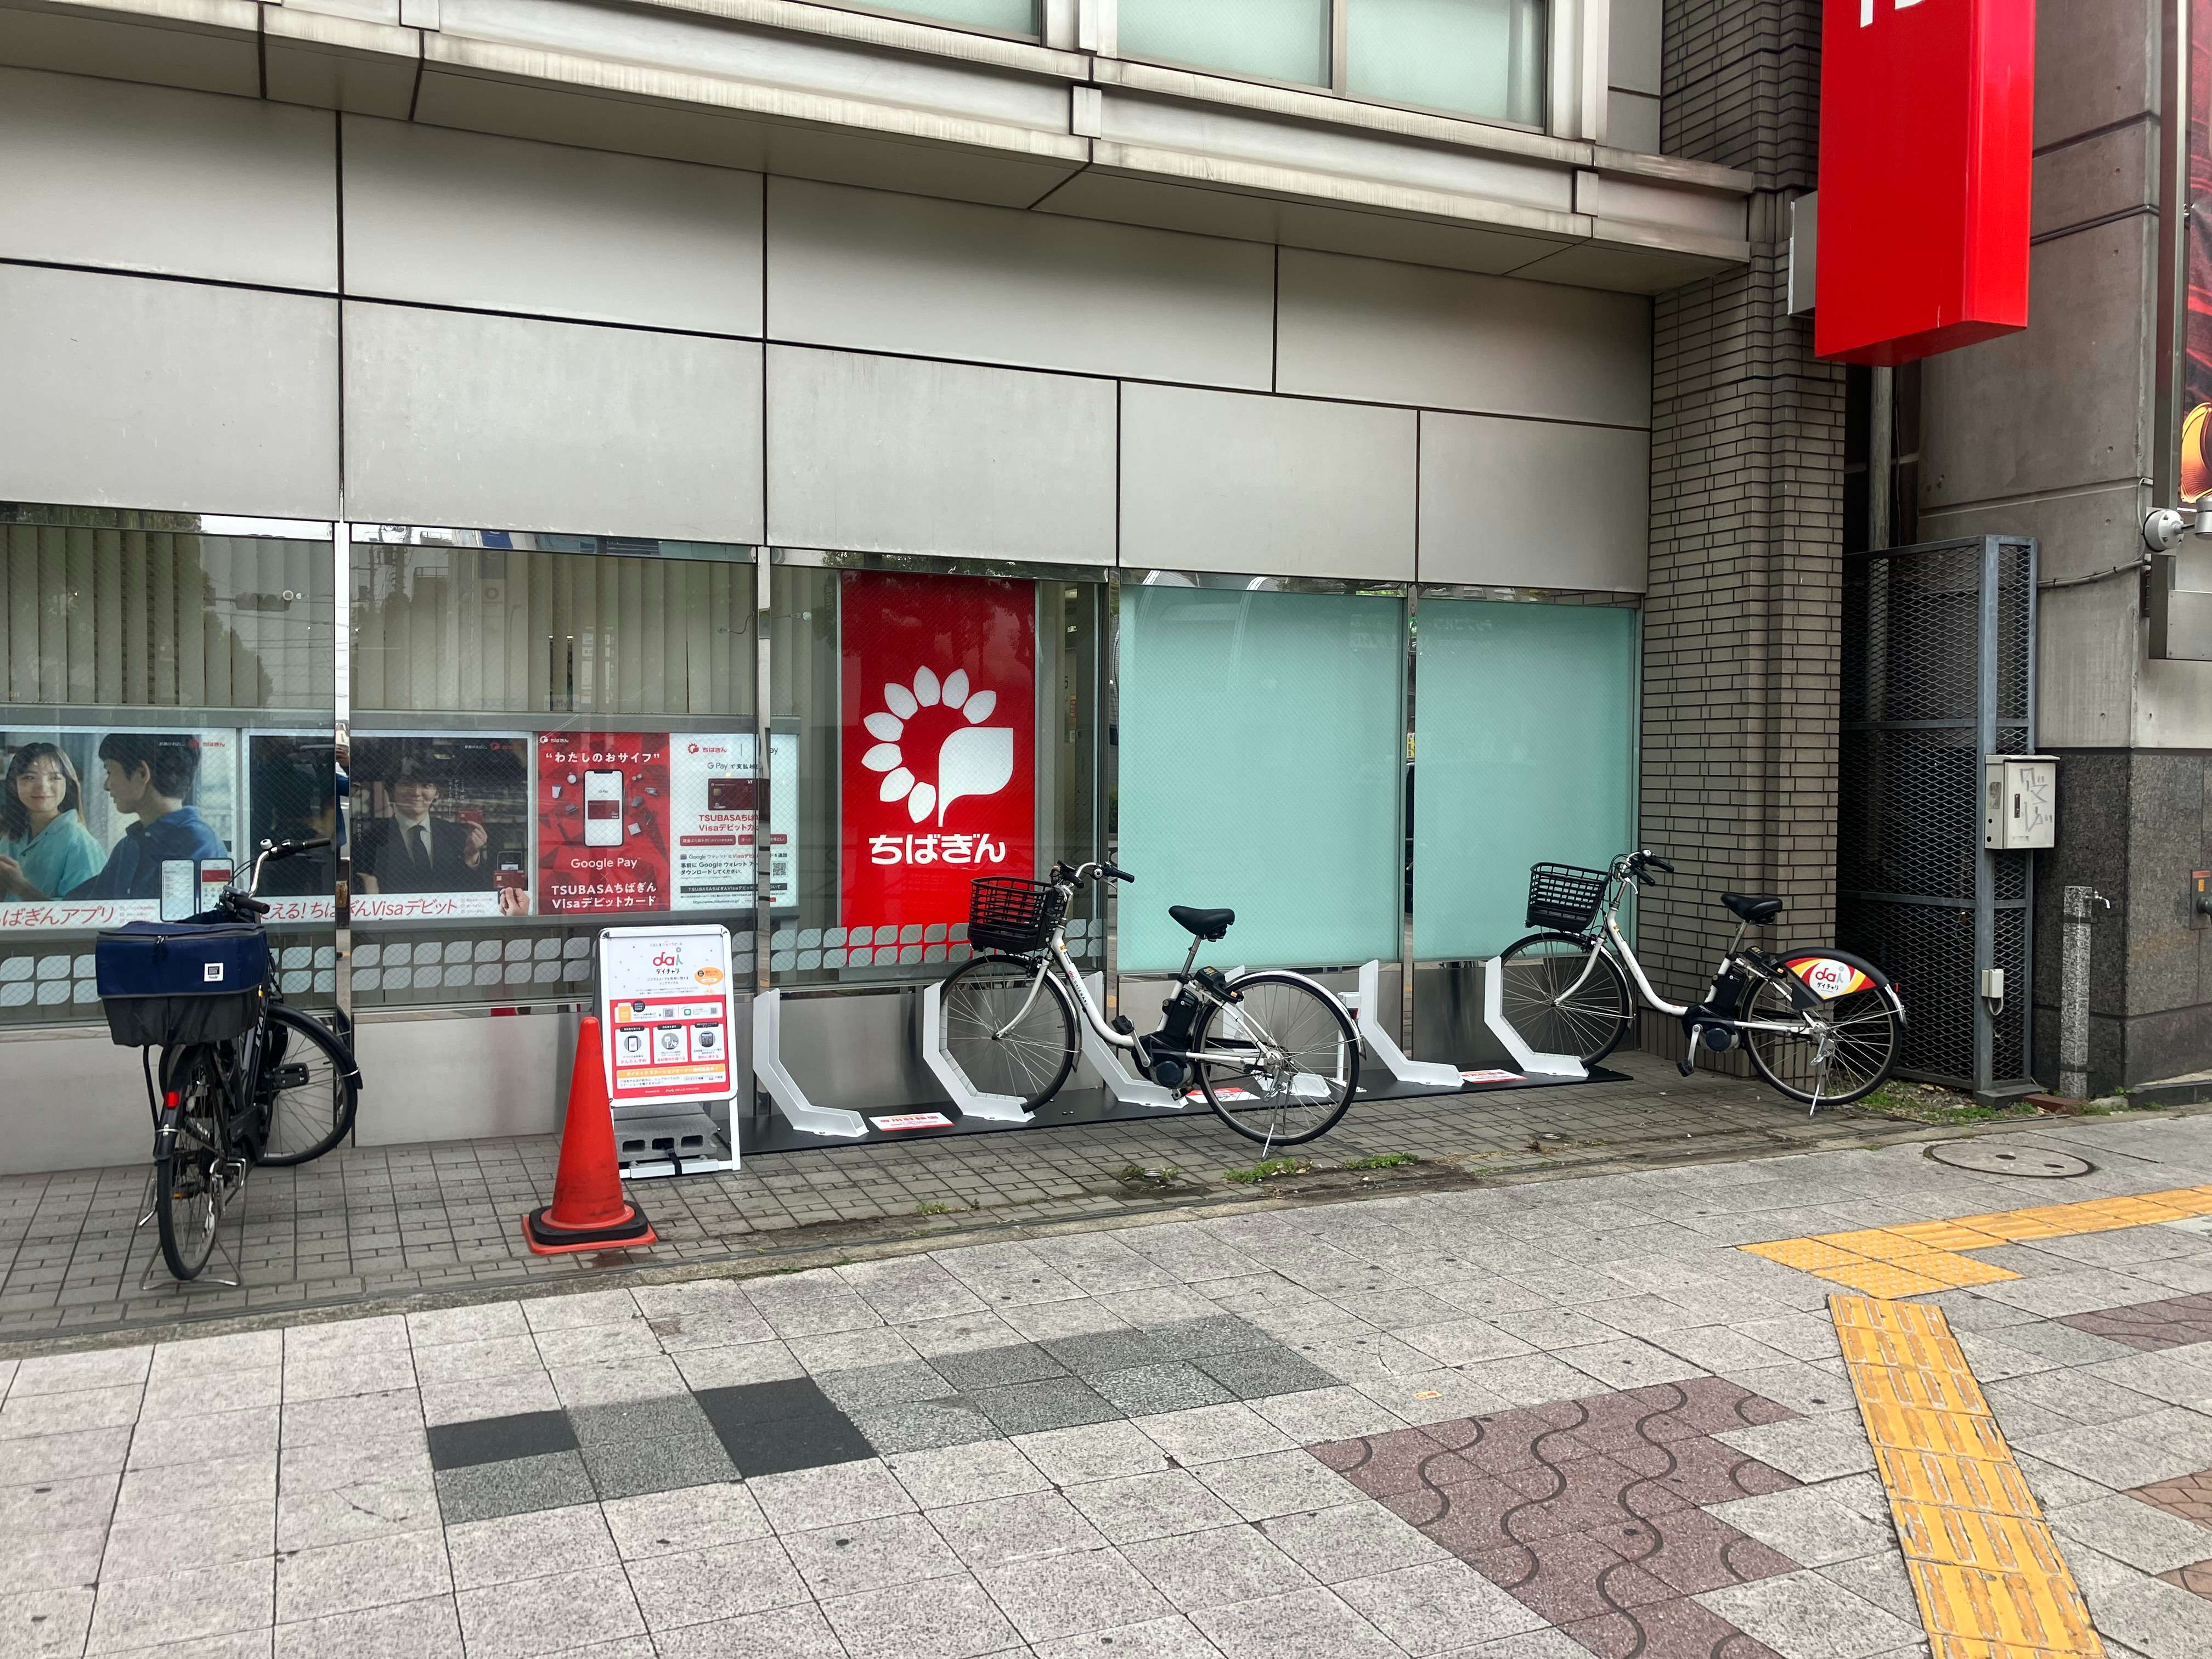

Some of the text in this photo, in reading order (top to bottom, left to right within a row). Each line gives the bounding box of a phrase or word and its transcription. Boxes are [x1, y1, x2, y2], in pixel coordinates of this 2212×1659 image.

[715, 763, 729, 771] Pay
[869, 833, 1006, 865] ちばぎん
[571, 857, 638, 870] Google Pay
[551, 882, 657, 895] TSUBASAちばぎん
[552, 895, 656, 909] Visaデビットカード
[0, 905, 114, 926] ばぎんアプリ
[1815, 966, 1844, 984] dai
[1817, 982, 1839, 991] ダイチャリ
